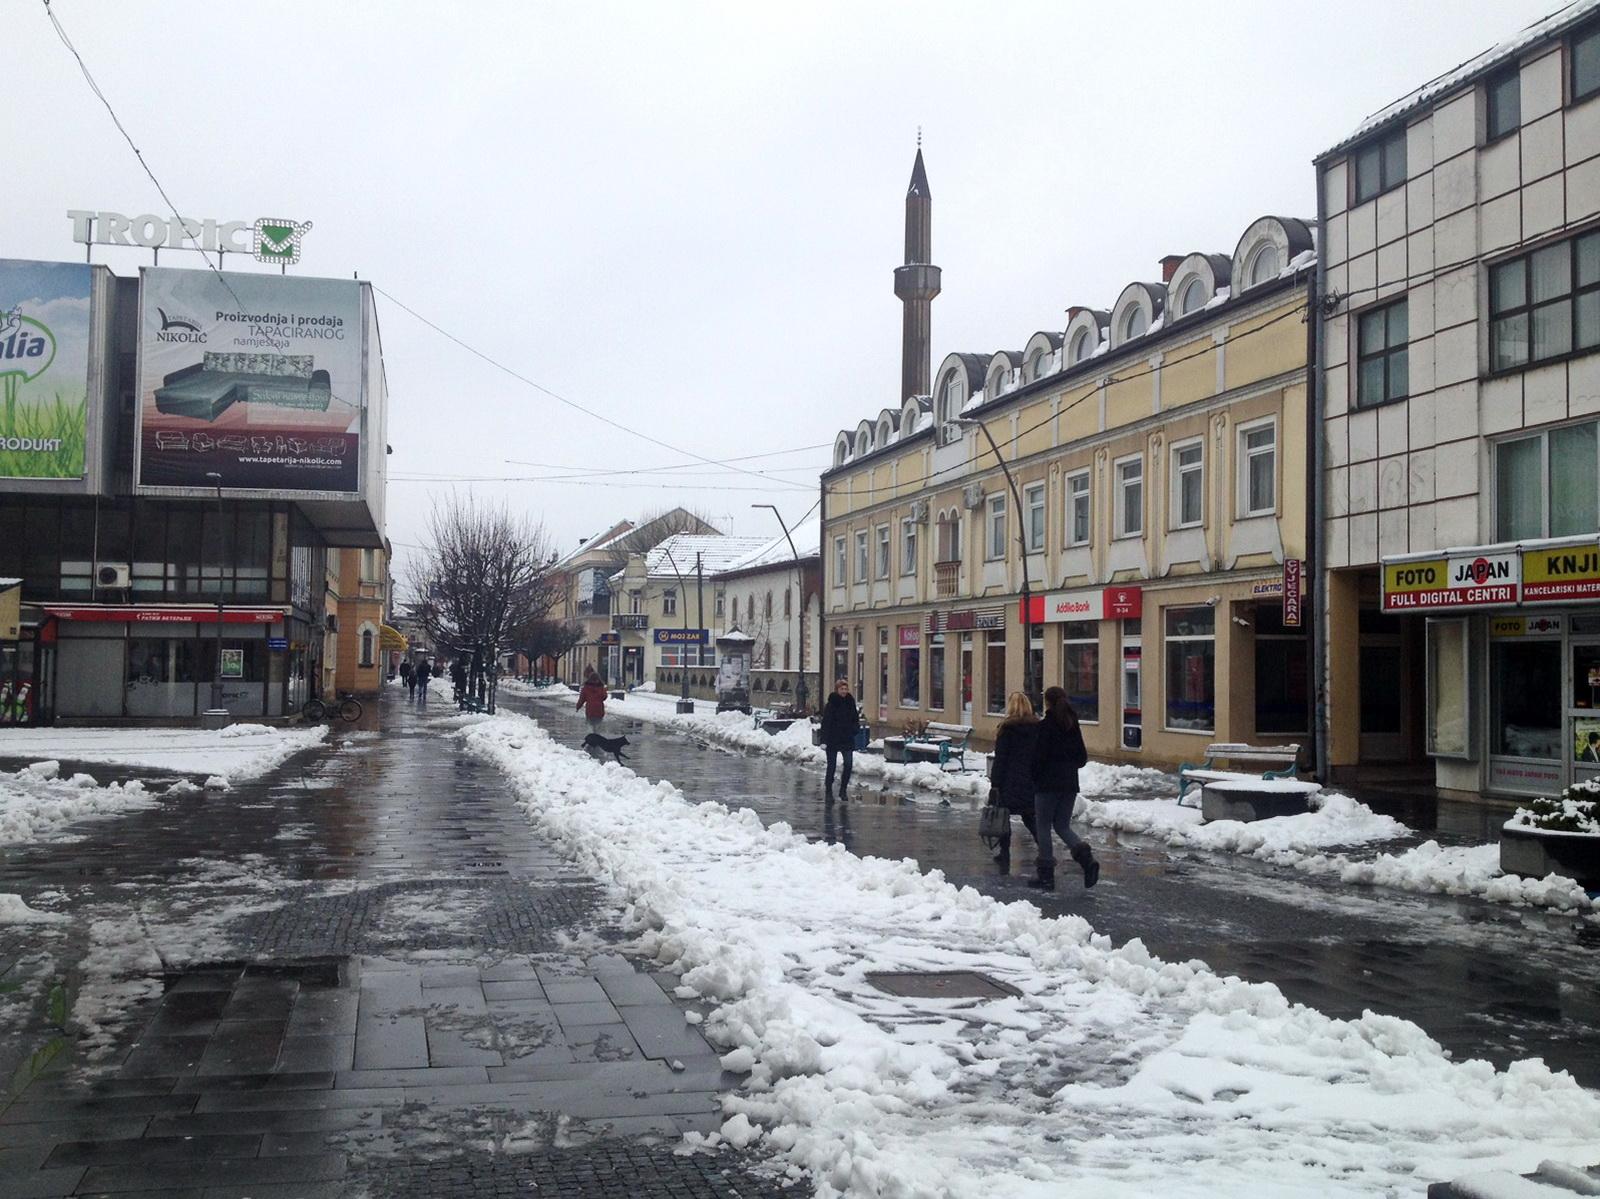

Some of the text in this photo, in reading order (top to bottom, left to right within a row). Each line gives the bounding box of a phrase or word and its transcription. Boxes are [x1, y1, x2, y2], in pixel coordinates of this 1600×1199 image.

[67, 209, 247, 253] TROPIC
[215, 311, 343, 328] Proizvodnja i prodaja
[247, 325, 345, 341] TAPACIRANOG
[238, 455, 342, 466] www.tapetarija-nikolic.com
[1455, 561, 1510, 582] JAPAN
[1547, 553, 1598, 575] KNJI
[1396, 567, 1435, 587] FOTO
[1253, 583, 1282, 593] ELEKTRO
[1524, 585, 1575, 595] KANCELARISKI
[1390, 587, 1510, 607] FULL DIGITAL CENTRI
[1495, 620, 1560, 632] FOTO JAPAN
